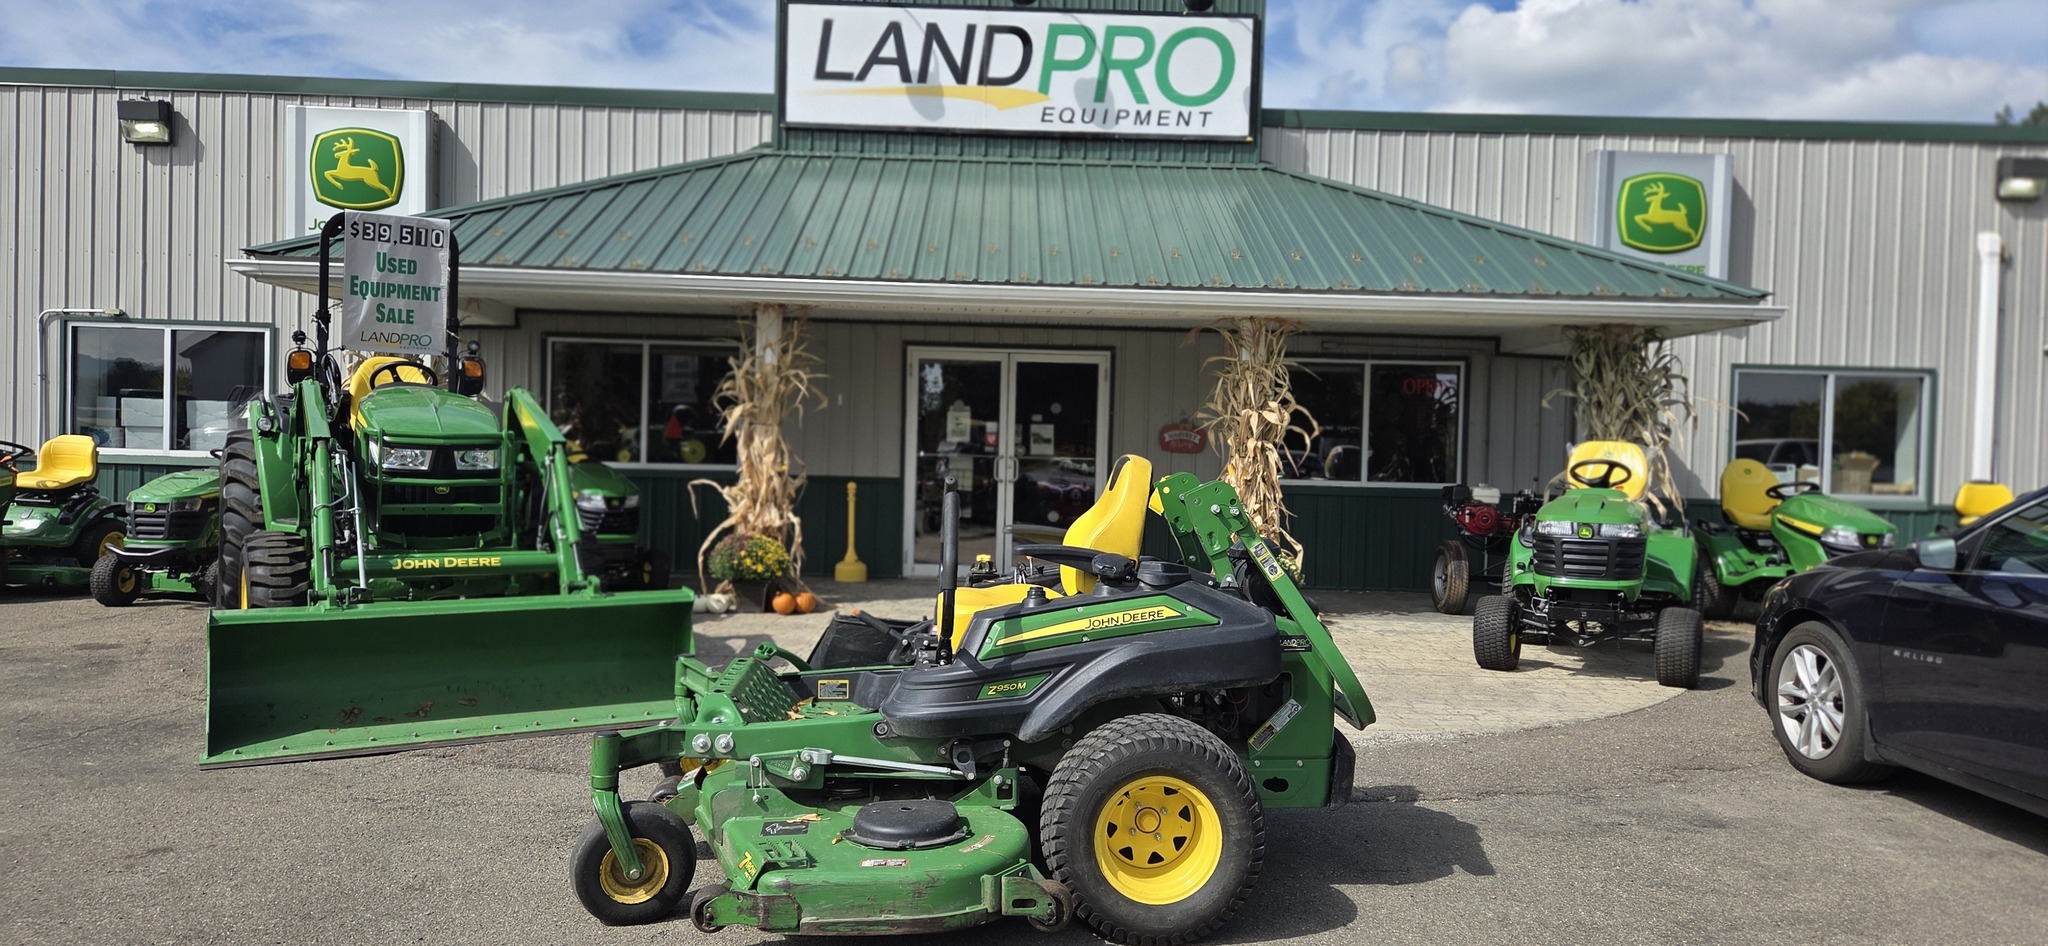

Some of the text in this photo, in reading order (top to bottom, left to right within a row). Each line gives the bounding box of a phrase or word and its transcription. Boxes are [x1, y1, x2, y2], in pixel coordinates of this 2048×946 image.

[814, 18, 1237, 108] LANDPRO
[1040, 106, 1214, 128] EQUIPMENT
[350, 220, 444, 248] $39,510
[349, 275, 441, 302] EQUIPMENT
[375, 303, 415, 325] SALE
[360, 330, 433, 347] LANDPRO
[392, 557, 501, 571] JOHN DEERE
[1086, 609, 1165, 630] JOHN DEERE
[987, 681, 1027, 696] Z950M
